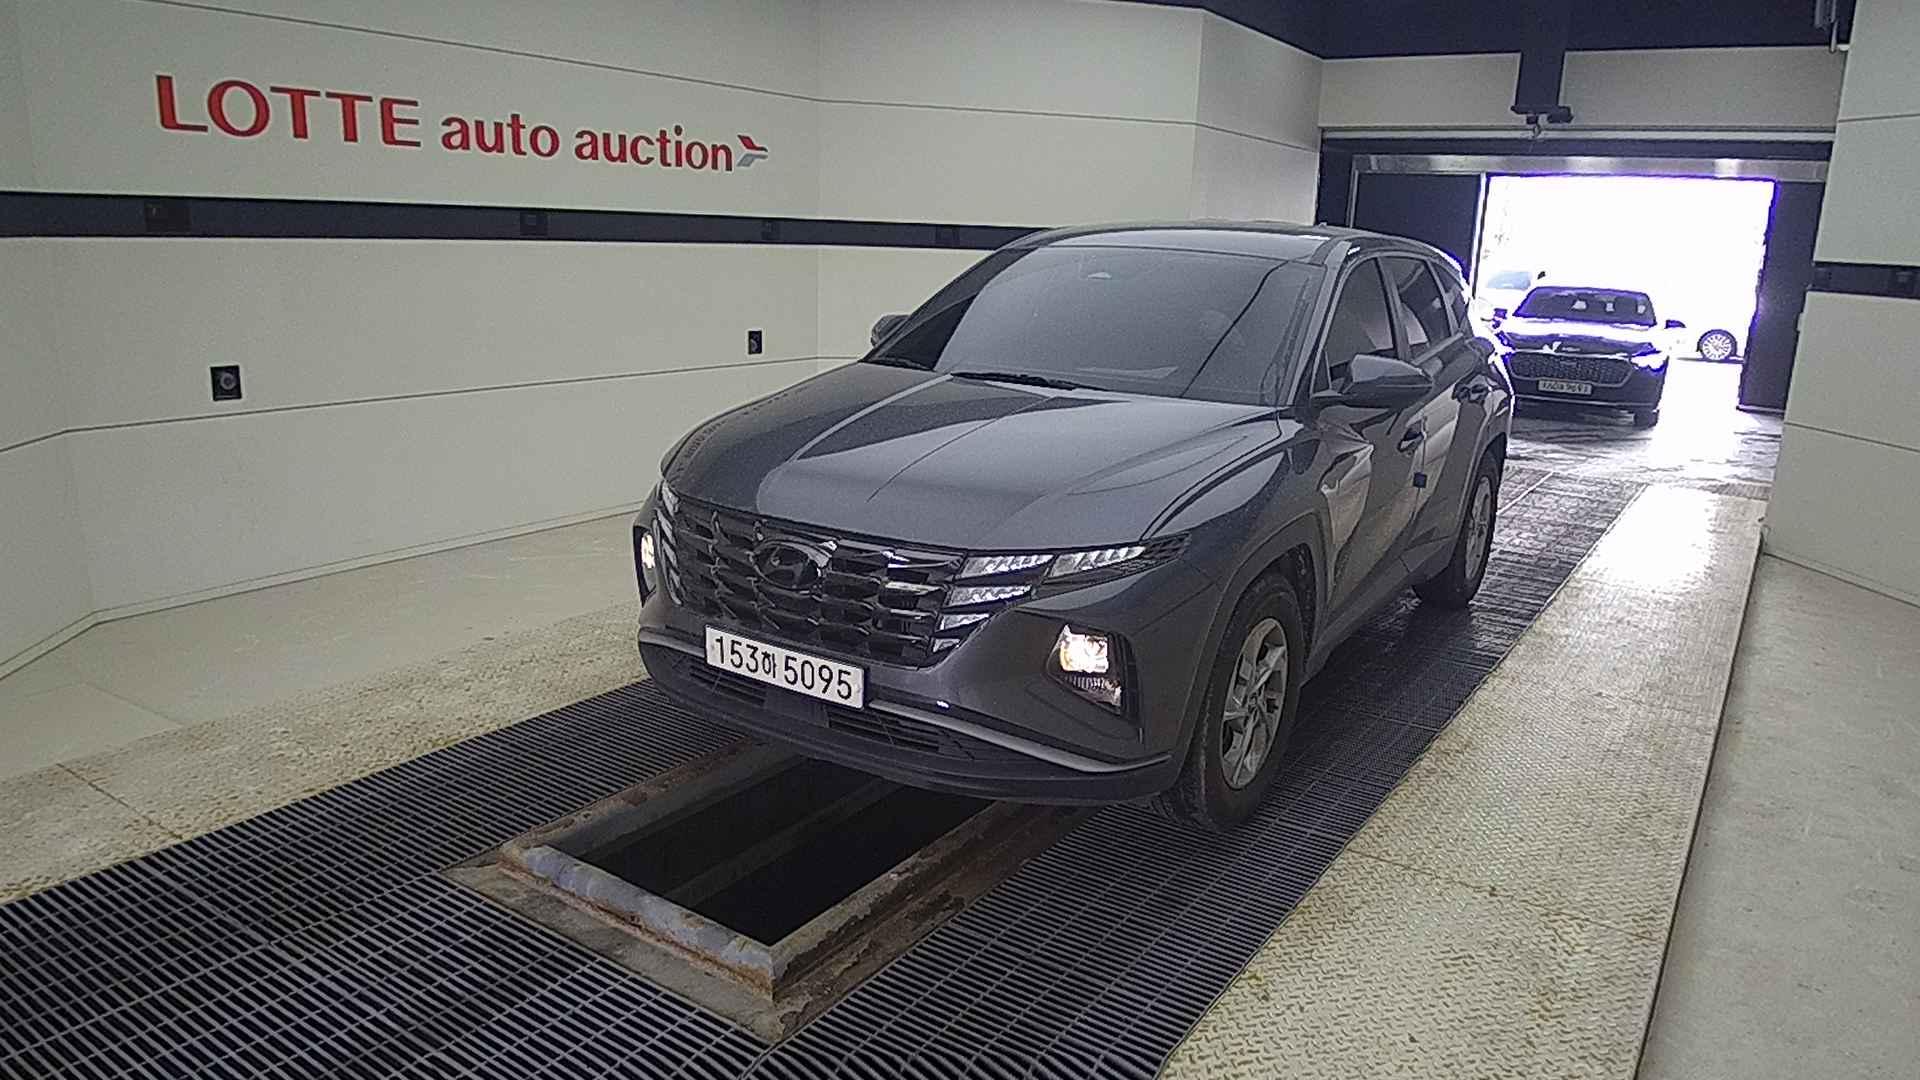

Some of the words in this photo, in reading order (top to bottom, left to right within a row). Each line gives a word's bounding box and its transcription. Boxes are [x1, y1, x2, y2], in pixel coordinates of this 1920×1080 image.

[155, 75, 421, 148] LOTTE
[441, 113, 560, 158] auto
[576, 125, 733, 171] auction
